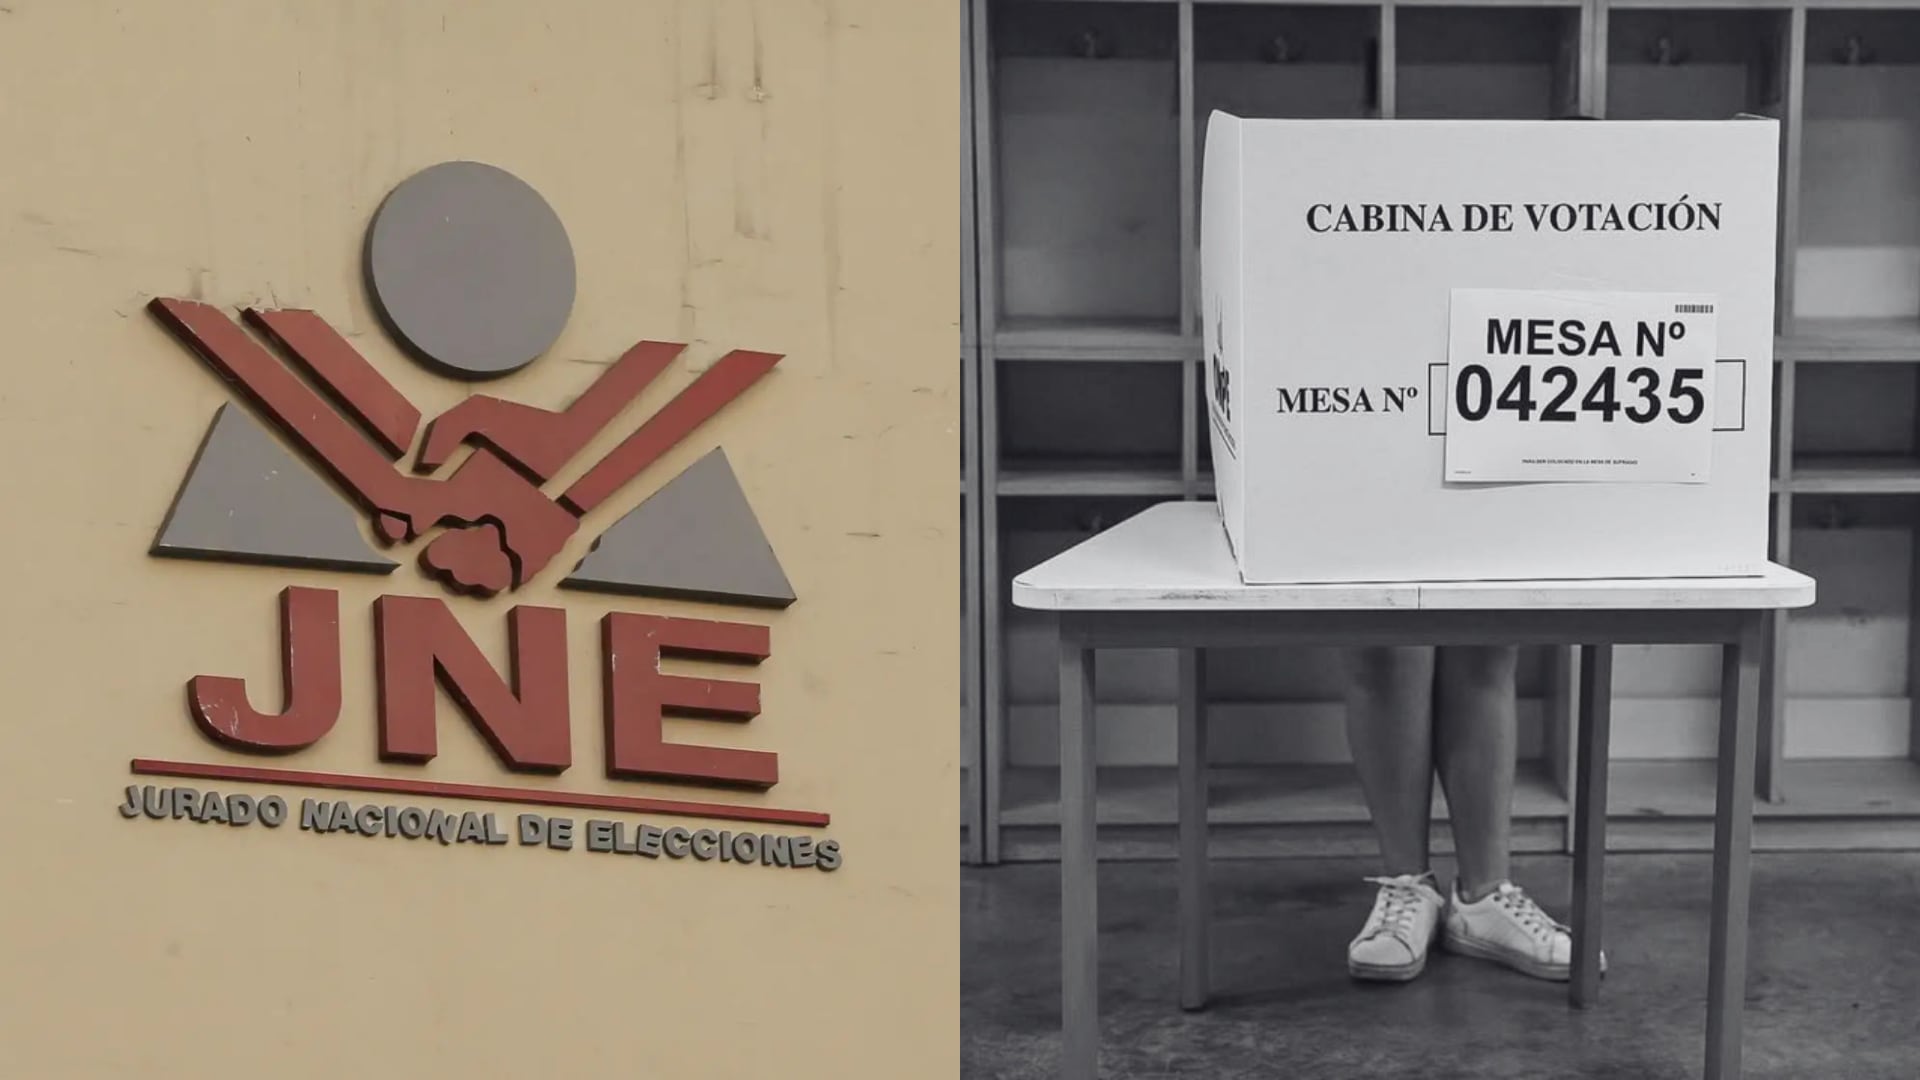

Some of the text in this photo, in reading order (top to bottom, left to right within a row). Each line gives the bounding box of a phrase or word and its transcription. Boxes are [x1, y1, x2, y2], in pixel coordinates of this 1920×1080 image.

[1306, 194, 1722, 232] CABINA DE VOTACIÓN
[1487, 319, 1622, 357] MESA
[1277, 387, 1375, 413] MESA
[1455, 364, 1705, 424] 042435
[187, 585, 779, 790] JNE
[119, 785, 843, 872] JURADO NACIONAL DE ELECCIONES
